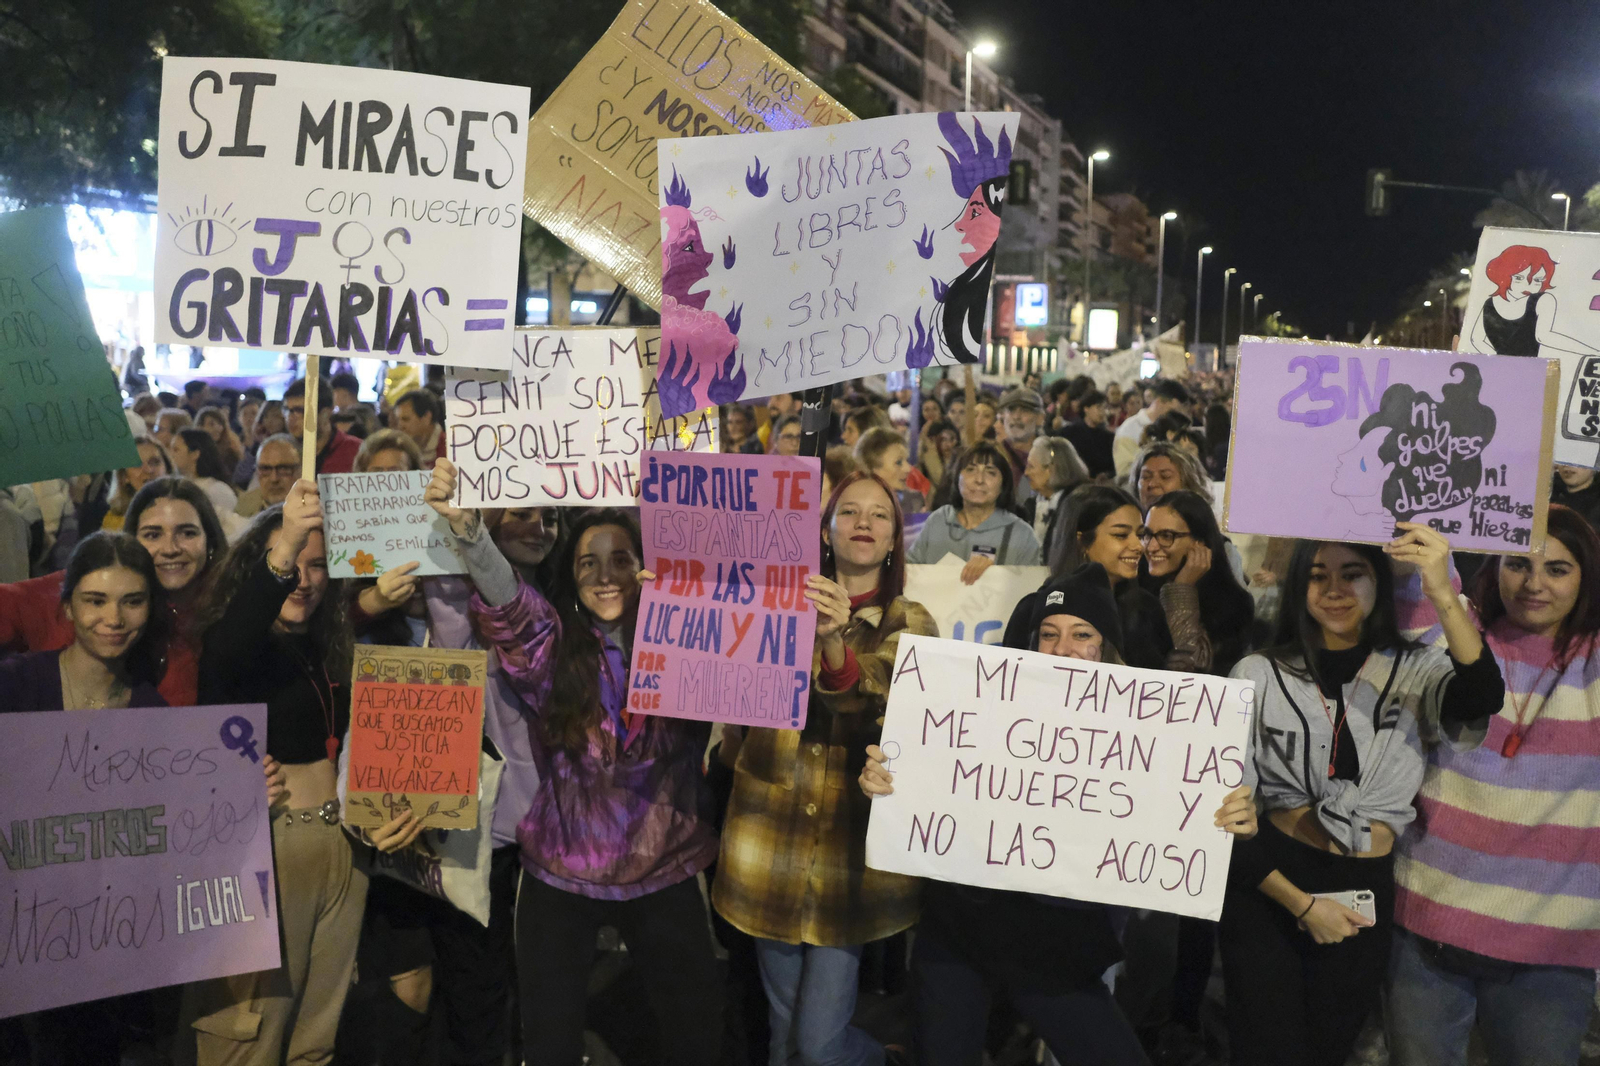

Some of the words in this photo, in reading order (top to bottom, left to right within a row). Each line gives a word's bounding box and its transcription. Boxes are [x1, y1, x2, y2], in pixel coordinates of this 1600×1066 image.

[632, 0, 741, 90] ELLOS
[756, 62, 800, 102] NOS
[178, 69, 278, 160] SI
[294, 98, 519, 190] MIRASES
[644, 88, 729, 138] NOS
[782, 139, 912, 203] JUNTAS
[305, 187, 372, 216] con
[390, 195, 518, 229] nuestros
[773, 188, 908, 256] LIBRES
[822, 249, 843, 286] Y
[169, 266, 450, 356] GRITARIAS
[788, 281, 859, 328] SIN
[610, 336, 661, 369] ME
[754, 314, 903, 387] MIEDO
[9, 359, 59, 387] TUS
[569, 376, 659, 410] SOLA
[1278, 354, 1390, 428] 25N
[26, 394, 128, 445] POLLAS
[1411, 402, 1450, 430] ni
[450, 420, 586, 462] PORQUE
[1397, 420, 1484, 468] golpes
[321, 473, 411, 495] TRATARON
[419, 473, 433, 489] D
[457, 464, 531, 507] MOS
[540, 460, 638, 500] JUNT
[642, 456, 759, 513] ¿PORQUE
[772, 470, 811, 511] TE
[1395, 476, 1475, 514] duelan
[1412, 463, 1447, 493] que
[1485, 464, 1507, 487] ni
[325, 493, 426, 515] ENTERRARNOS
[327, 519, 346, 532] NO
[356, 513, 400, 530] SABÍAN
[406, 513, 428, 525] QUE
[331, 532, 375, 545] ÉRAMOS
[385, 535, 451, 552] SEMILLAS
[653, 509, 803, 562] ESPANTAS
[1428, 516, 1462, 536] que
[1471, 511, 1532, 546] Hieran
[654, 557, 705, 597] POR
[712, 560, 756, 605] LAS
[762, 565, 810, 612] QUE
[643, 601, 723, 654] LUCHAN
[725, 612, 755, 658] Y
[757, 614, 797, 667] NI
[633, 671, 661, 690] LAS
[637, 650, 666, 672] POR
[356, 686, 477, 714] AGRADEZCAN
[630, 692, 662, 710] QUE
[893, 644, 926, 692] A
[976, 654, 1024, 702] MÍ
[1052, 665, 1227, 727] TAMBIÉN
[356, 711, 386, 729] QUE
[392, 712, 464, 733] BUSCAMOS
[375, 730, 450, 755] JUSTICIA
[396, 753, 404, 767] Y
[413, 755, 433, 769] NO
[922, 708, 978, 749] ME
[1006, 718, 1157, 773] GUSTAN
[1182, 743, 1244, 789] LAS
[952, 759, 1134, 819] MUJERES
[1179, 791, 1203, 832] Y
[908, 811, 957, 857] NO
[986, 819, 1057, 870] LAS
[1096, 837, 1207, 897] ACOSO
